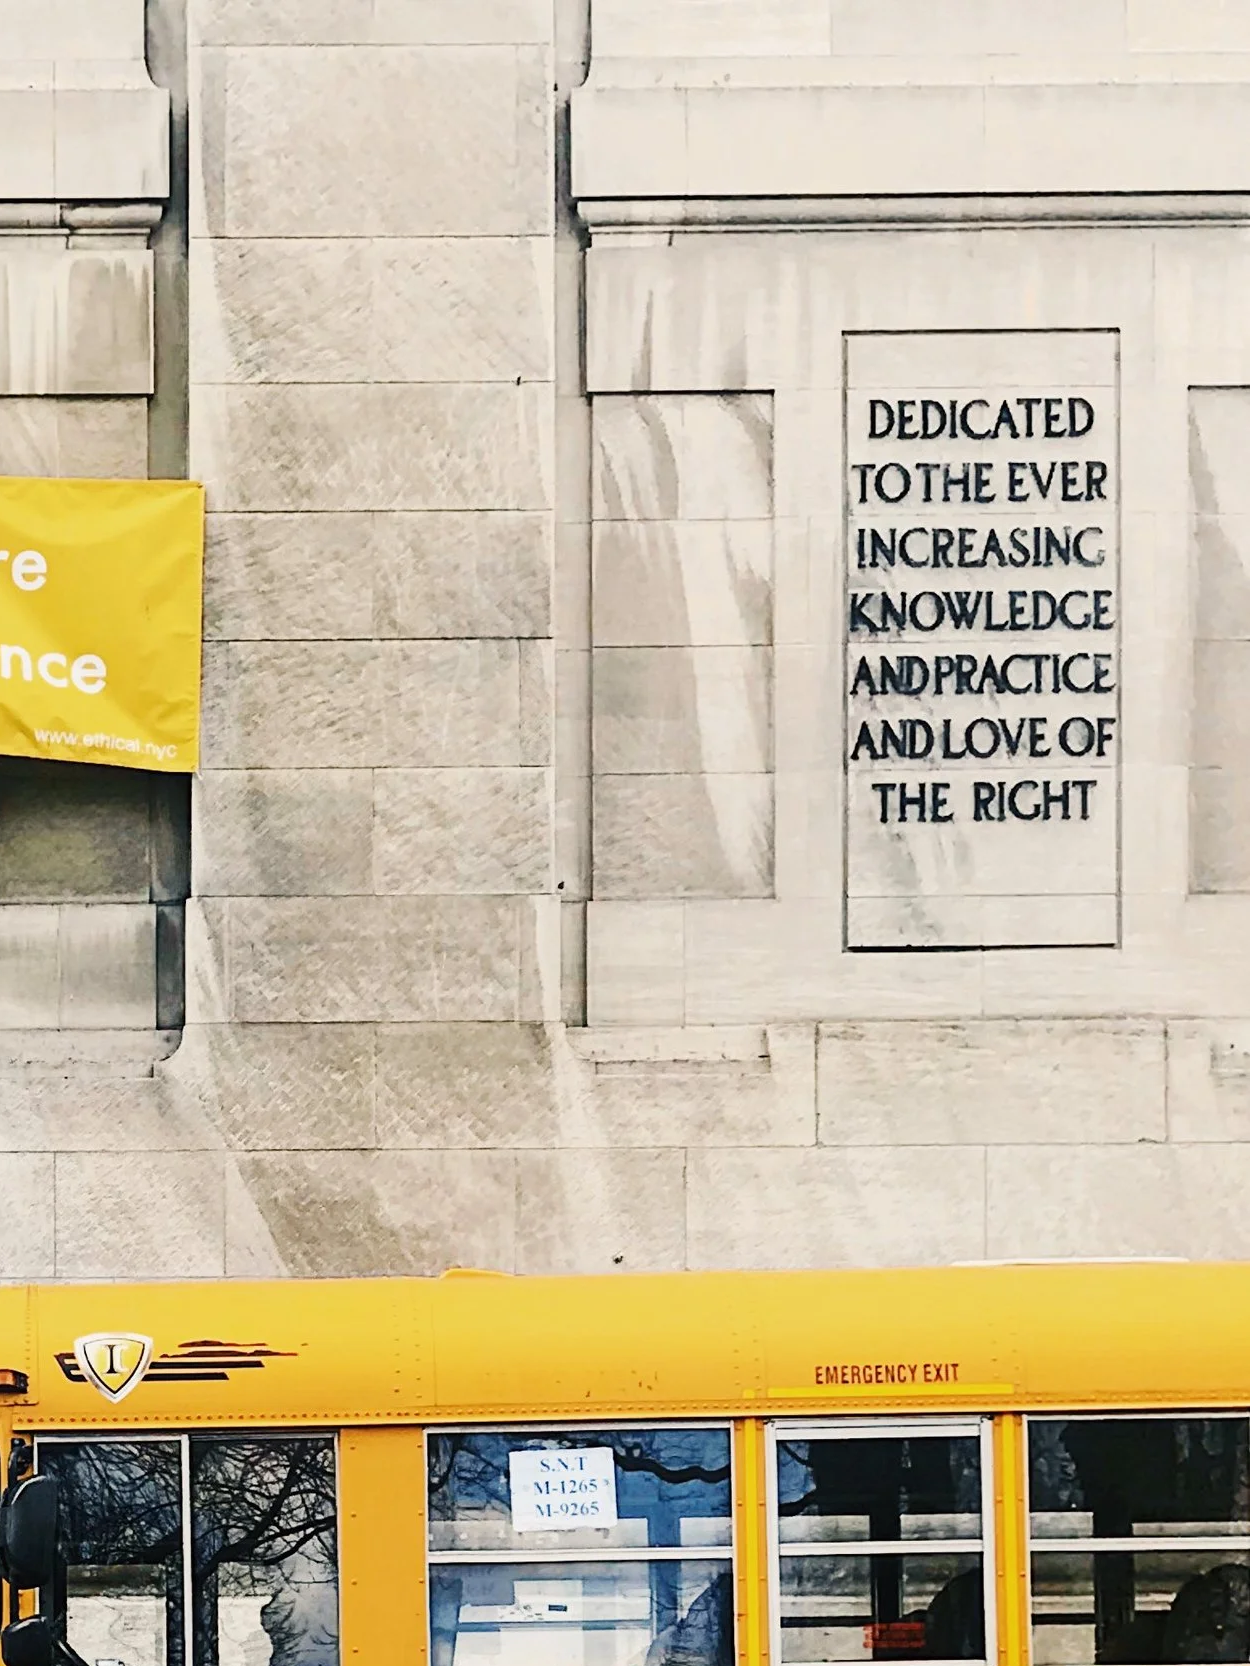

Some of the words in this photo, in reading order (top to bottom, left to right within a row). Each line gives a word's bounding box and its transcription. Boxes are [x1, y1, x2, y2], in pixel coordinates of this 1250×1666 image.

[868, 397, 1094, 440] DEDICATED
[851, 463, 911, 504] TO
[915, 462, 997, 503] THE
[1007, 461, 1107, 502] EVER
[857, 526, 1106, 568] INCREASING
[850, 590, 1116, 632] KNOWLEDGE
[850, 654, 930, 696] AND
[933, 653, 1116, 694] PRACTICE
[34, 728, 178, 761] www.ethical.nyc
[850, 718, 934, 760] AND
[943, 717, 1051, 759] LOVE
[1058, 717, 1116, 758] OF
[871, 782, 954, 823] THE
[973, 780, 1097, 822] RIGHT
[815, 1365, 917, 1384] EMERGENCY
[923, 1363, 959, 1383] EXIT
[539, 1457, 587, 1472] S.N.T
[533, 1479, 598, 1495] M-1265
[535, 1502, 600, 1517] M-9265
